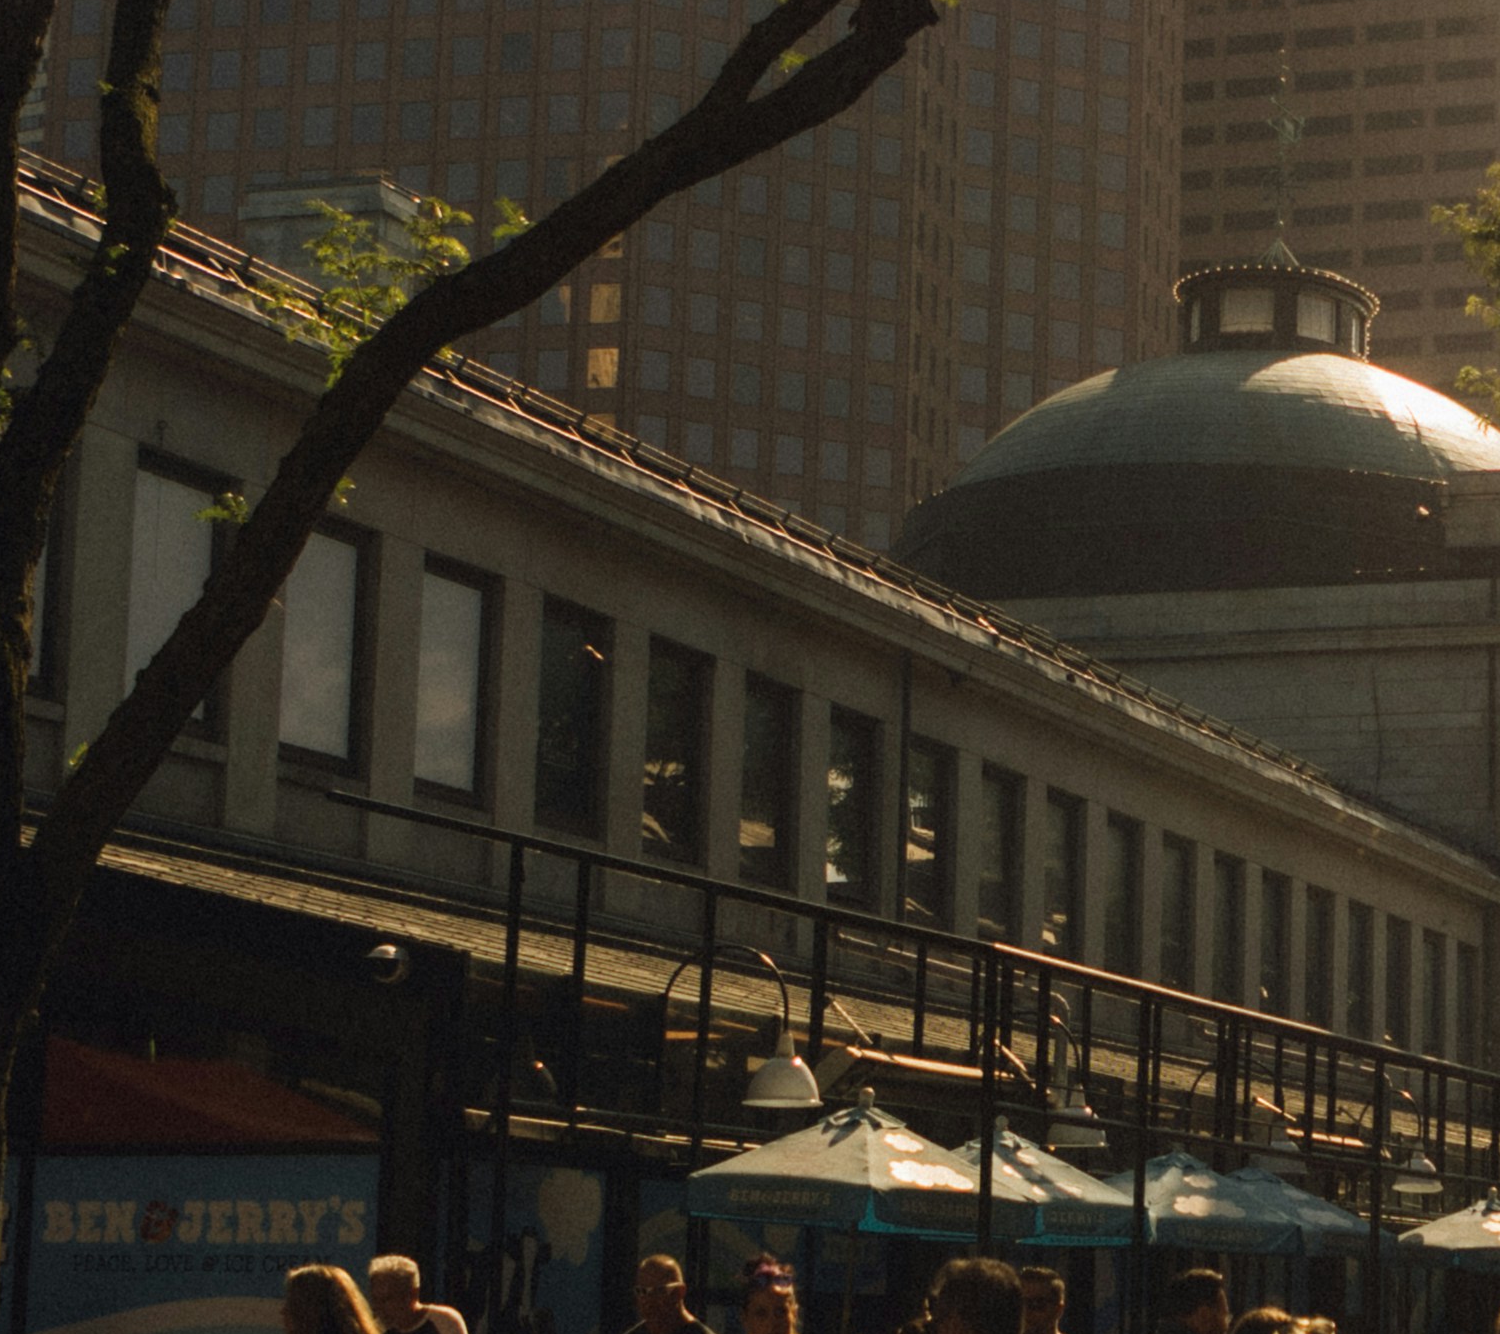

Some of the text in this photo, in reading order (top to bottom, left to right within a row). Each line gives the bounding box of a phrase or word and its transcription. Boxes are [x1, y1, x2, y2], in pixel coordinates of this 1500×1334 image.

[42, 1199, 138, 1245] BEN
[176, 1196, 367, 1245] JERRY'S
[144, 1253, 194, 1273] LOVE
[224, 1254, 256, 1273] ICE
